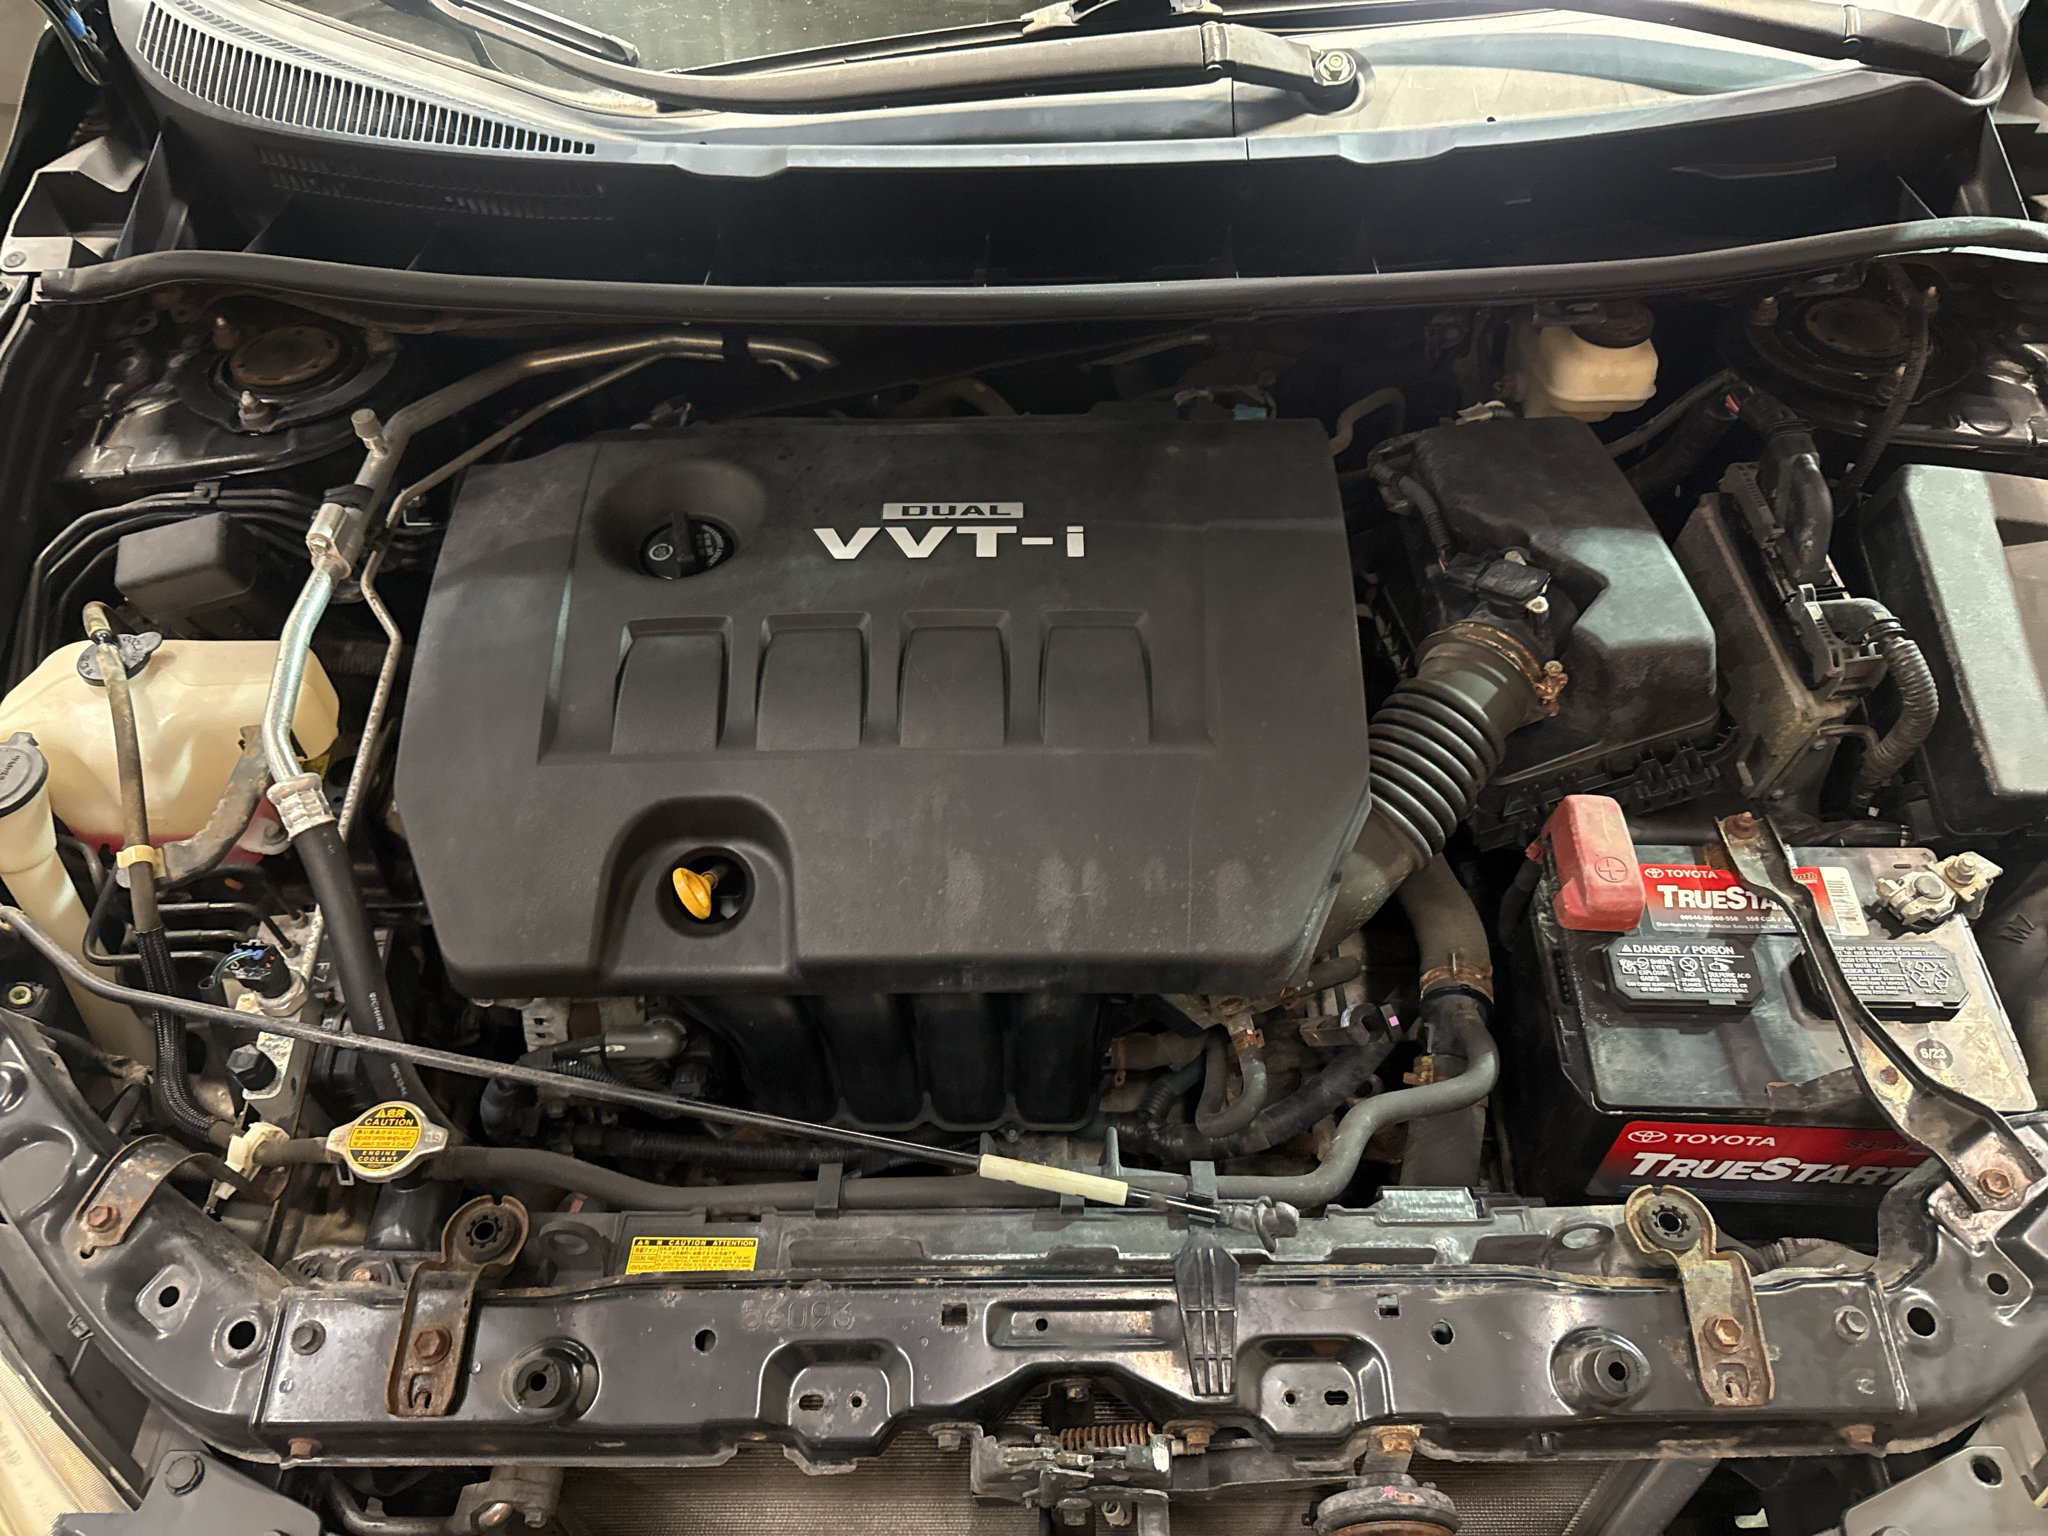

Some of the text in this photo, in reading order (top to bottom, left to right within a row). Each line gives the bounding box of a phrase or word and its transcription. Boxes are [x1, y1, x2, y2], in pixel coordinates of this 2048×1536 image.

[901, 505, 1012, 517] DUAL
[812, 525, 1085, 560] VVT-i
[1665, 869, 1718, 879] TOYOTA
[1657, 885, 1784, 910] TRUESTA
[1632, 944, 1681, 954] DANGER
[1691, 945, 1735, 955] POISON
[1919, 1047, 1948, 1060] 6/23
[364, 1118, 415, 1126] CAUTION
[1673, 1132, 1776, 1147] TOYOTA
[1630, 1151, 1915, 1187] TRUESTART
[712, 1239, 754, 1247] ATTENTION
